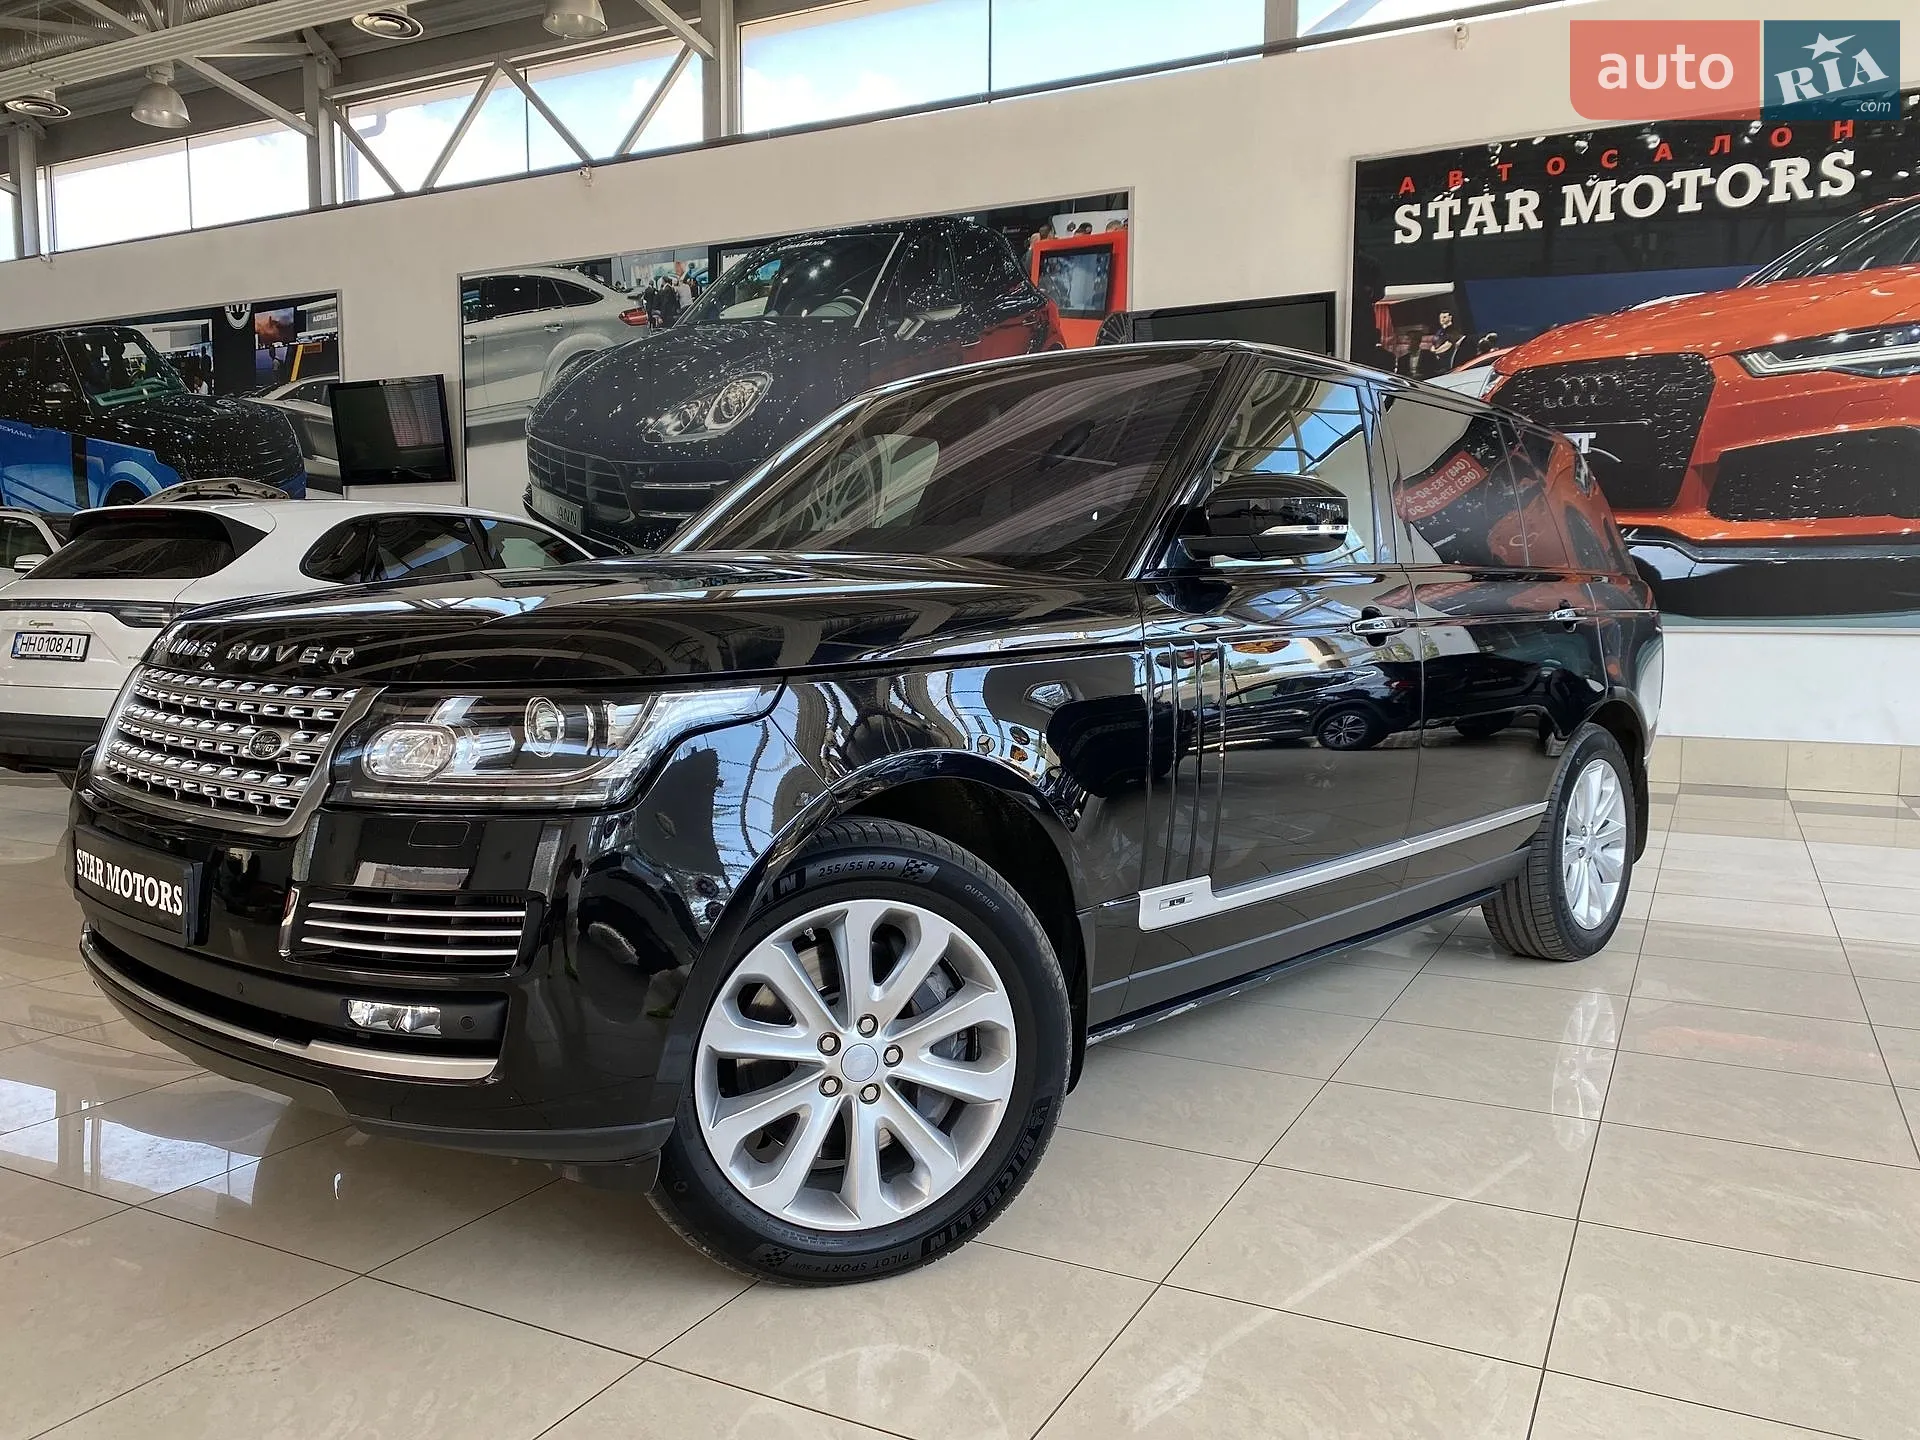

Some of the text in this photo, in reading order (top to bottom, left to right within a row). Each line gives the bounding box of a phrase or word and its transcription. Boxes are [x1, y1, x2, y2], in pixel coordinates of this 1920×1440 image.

[1393, 149, 1857, 245] STAR MOTORS
[226, 642, 355, 665] ROVER
[76, 848, 183, 916] STAR MOTORS
[818, 860, 896, 878] 255/55 R 20
[964, 883, 1001, 913] OUTSIDE
[928, 1132, 1037, 1252] MICHELIN
[822, 1262, 868, 1274] SPORT
[872, 1252, 910, 1269] PILOT
